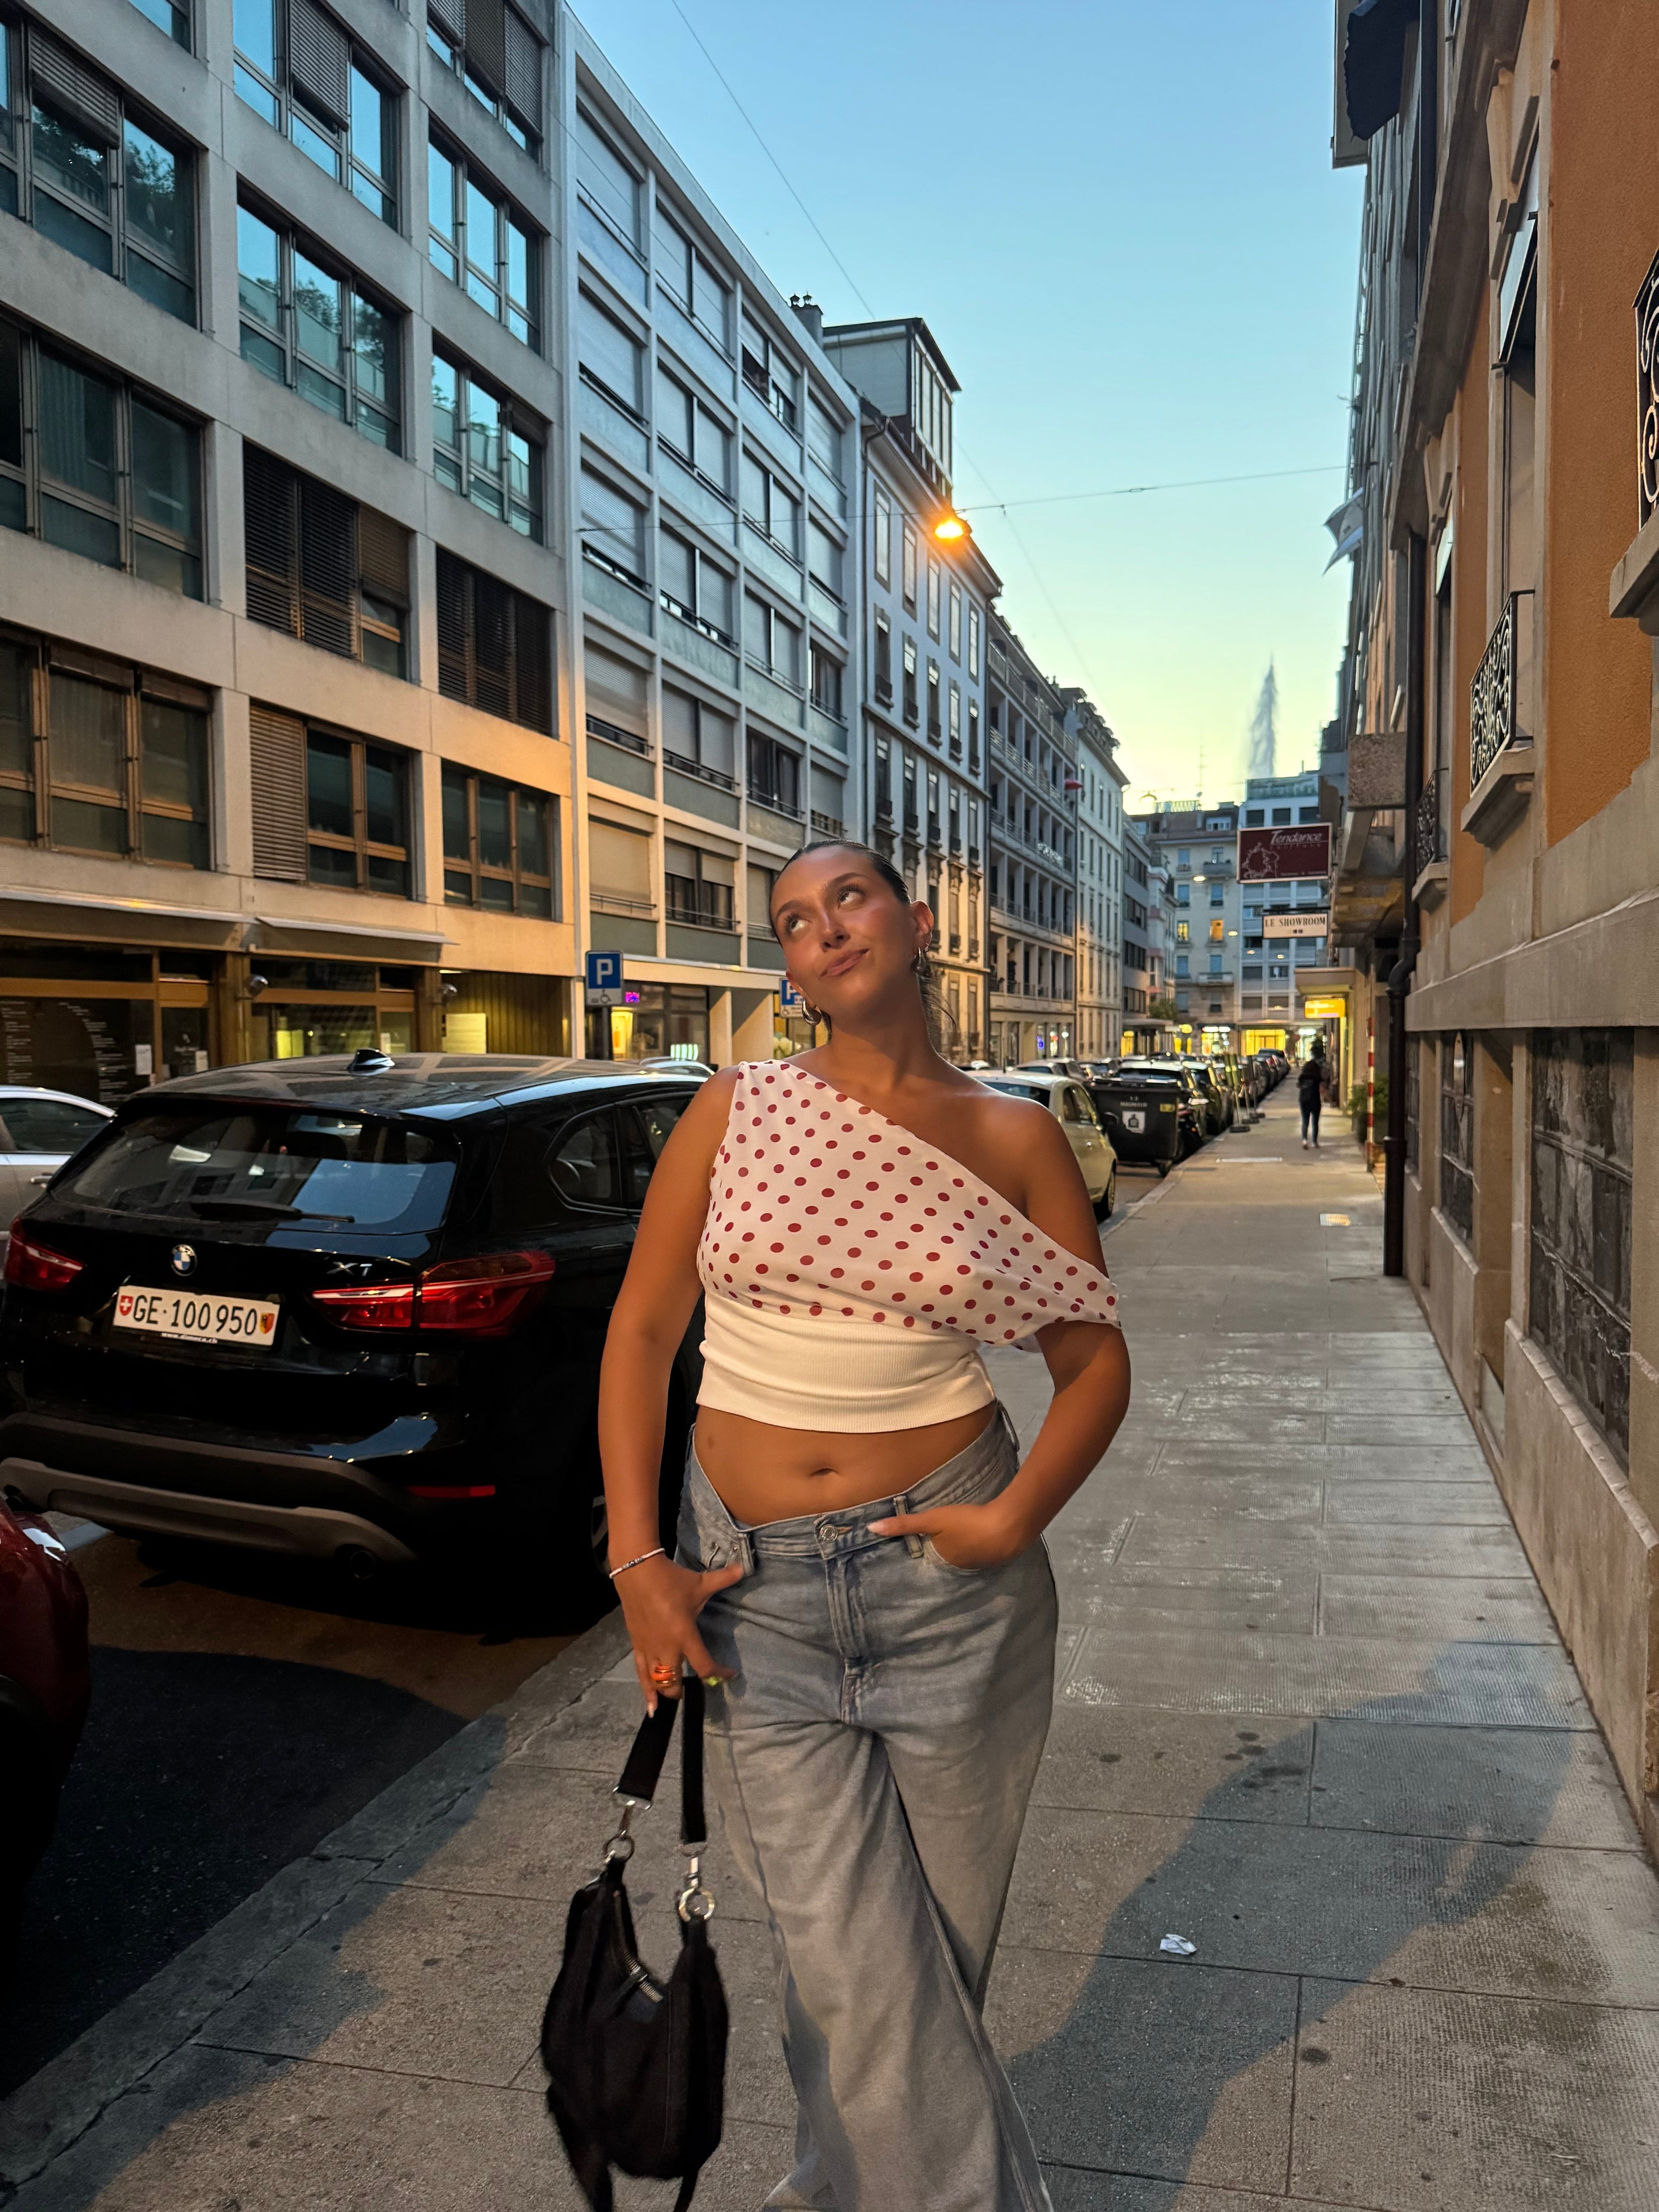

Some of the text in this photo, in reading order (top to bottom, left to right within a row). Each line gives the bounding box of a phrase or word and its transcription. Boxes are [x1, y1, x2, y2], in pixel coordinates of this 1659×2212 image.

[1270, 829, 1322, 845] Tendance
[1265, 916, 1325, 927] LE SHOWROOM
[597, 958, 613, 985] P
